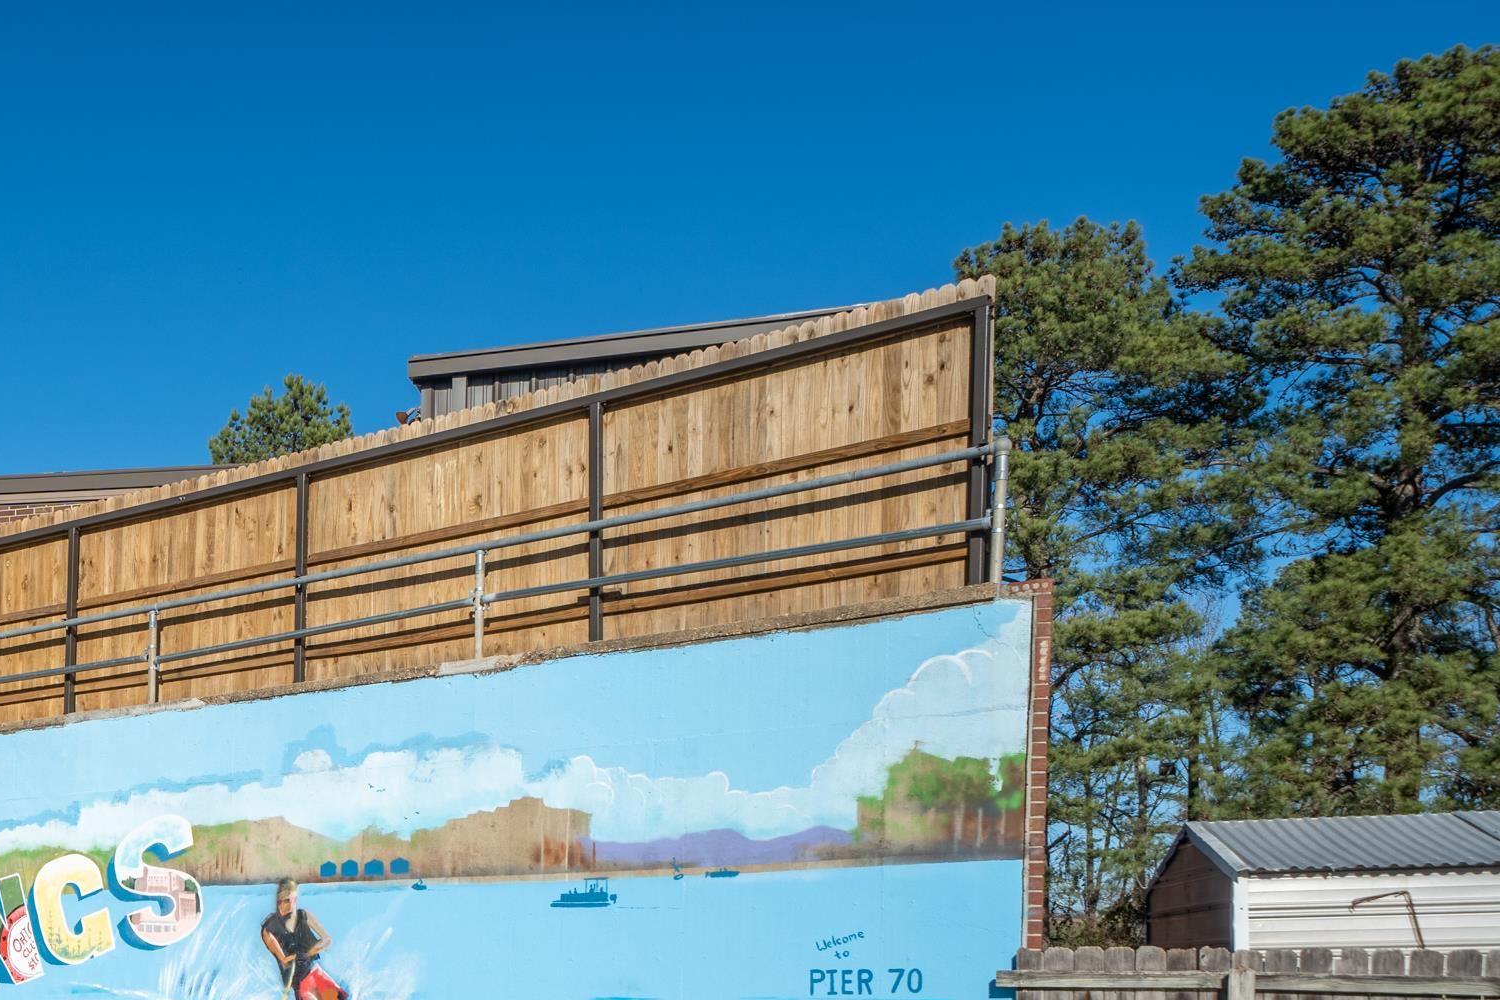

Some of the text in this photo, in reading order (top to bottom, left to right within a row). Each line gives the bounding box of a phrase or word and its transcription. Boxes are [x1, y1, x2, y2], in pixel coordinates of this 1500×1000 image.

[815, 930, 865, 952] Welcome
[834, 949, 850, 960] to
[809, 968, 924, 996] PIER 70
